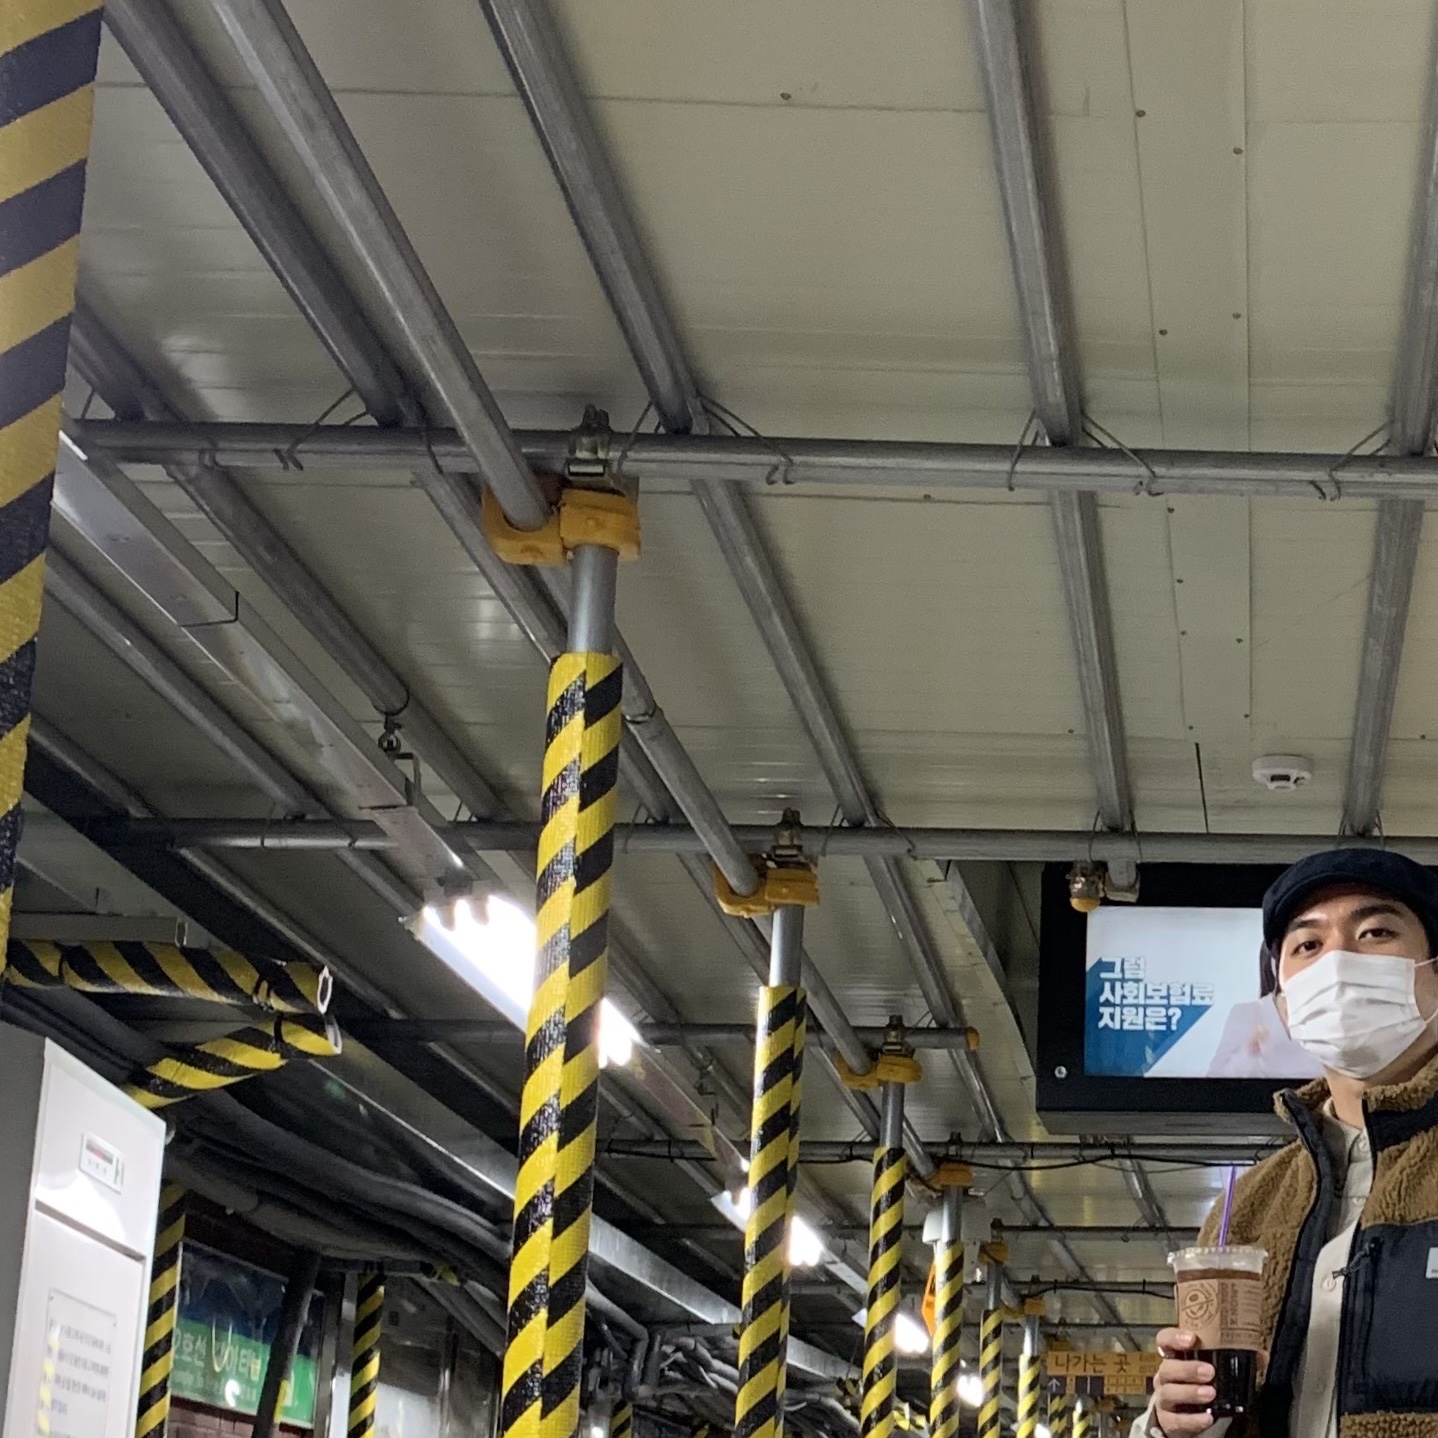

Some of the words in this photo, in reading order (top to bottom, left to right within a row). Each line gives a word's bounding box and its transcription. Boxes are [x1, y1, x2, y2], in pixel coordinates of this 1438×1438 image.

[1099, 980, 1214, 1006] 사회보험료
[1098, 1005, 1182, 1031] 지원은?
[1055, 1353, 1107, 1373] 나가는
[1113, 1353, 1131, 1373] 곳
